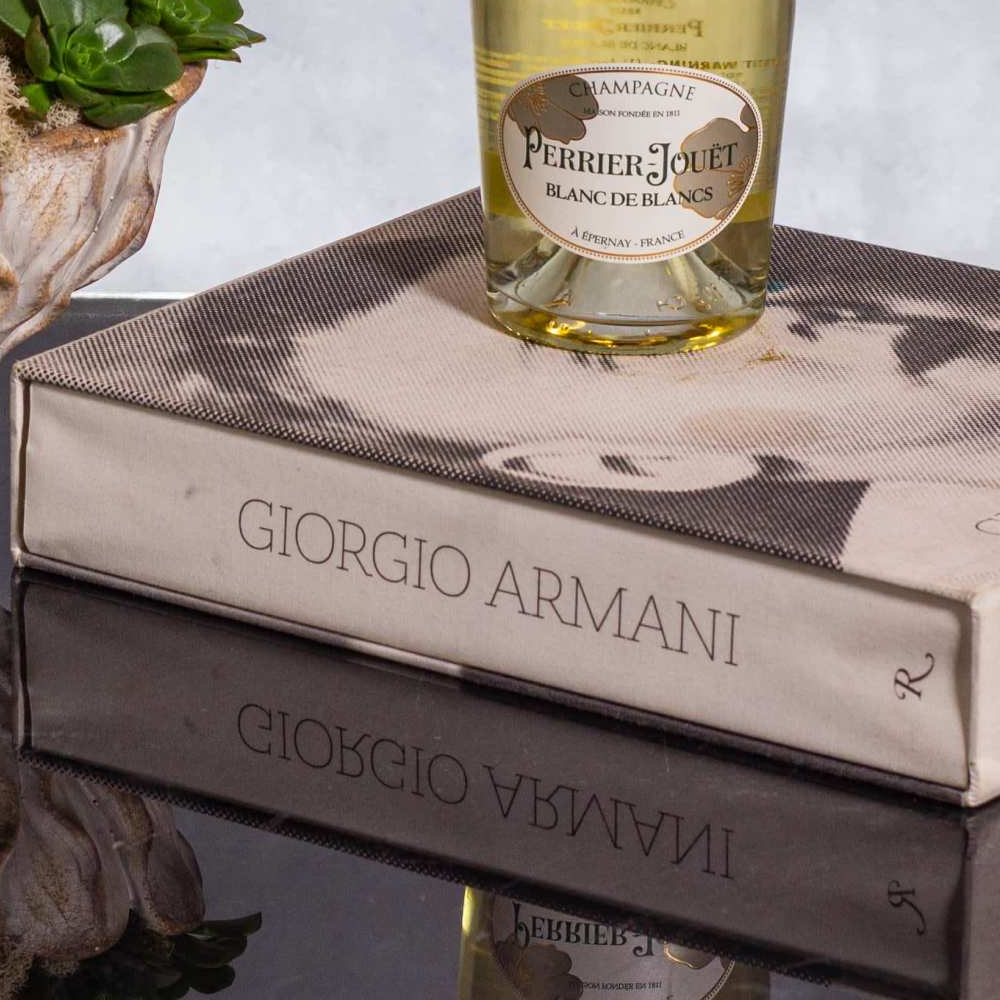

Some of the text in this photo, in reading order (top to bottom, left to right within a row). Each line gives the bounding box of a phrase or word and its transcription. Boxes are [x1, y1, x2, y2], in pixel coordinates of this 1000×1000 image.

[569, 79, 696, 101] CHAMPAGNE
[618, 109, 651, 118] FONDÉE
[653, 110, 664, 118] EN
[522, 126, 738, 186] PERRIER-JOUËT
[546, 182, 713, 207] BLANC DE BLANCS
[570, 225, 579, 238] À
[581, 230, 631, 248] ÉPERNAY
[640, 230, 685, 248] FRANCE
[237, 498, 741, 667] GIORGIO ARMANI
